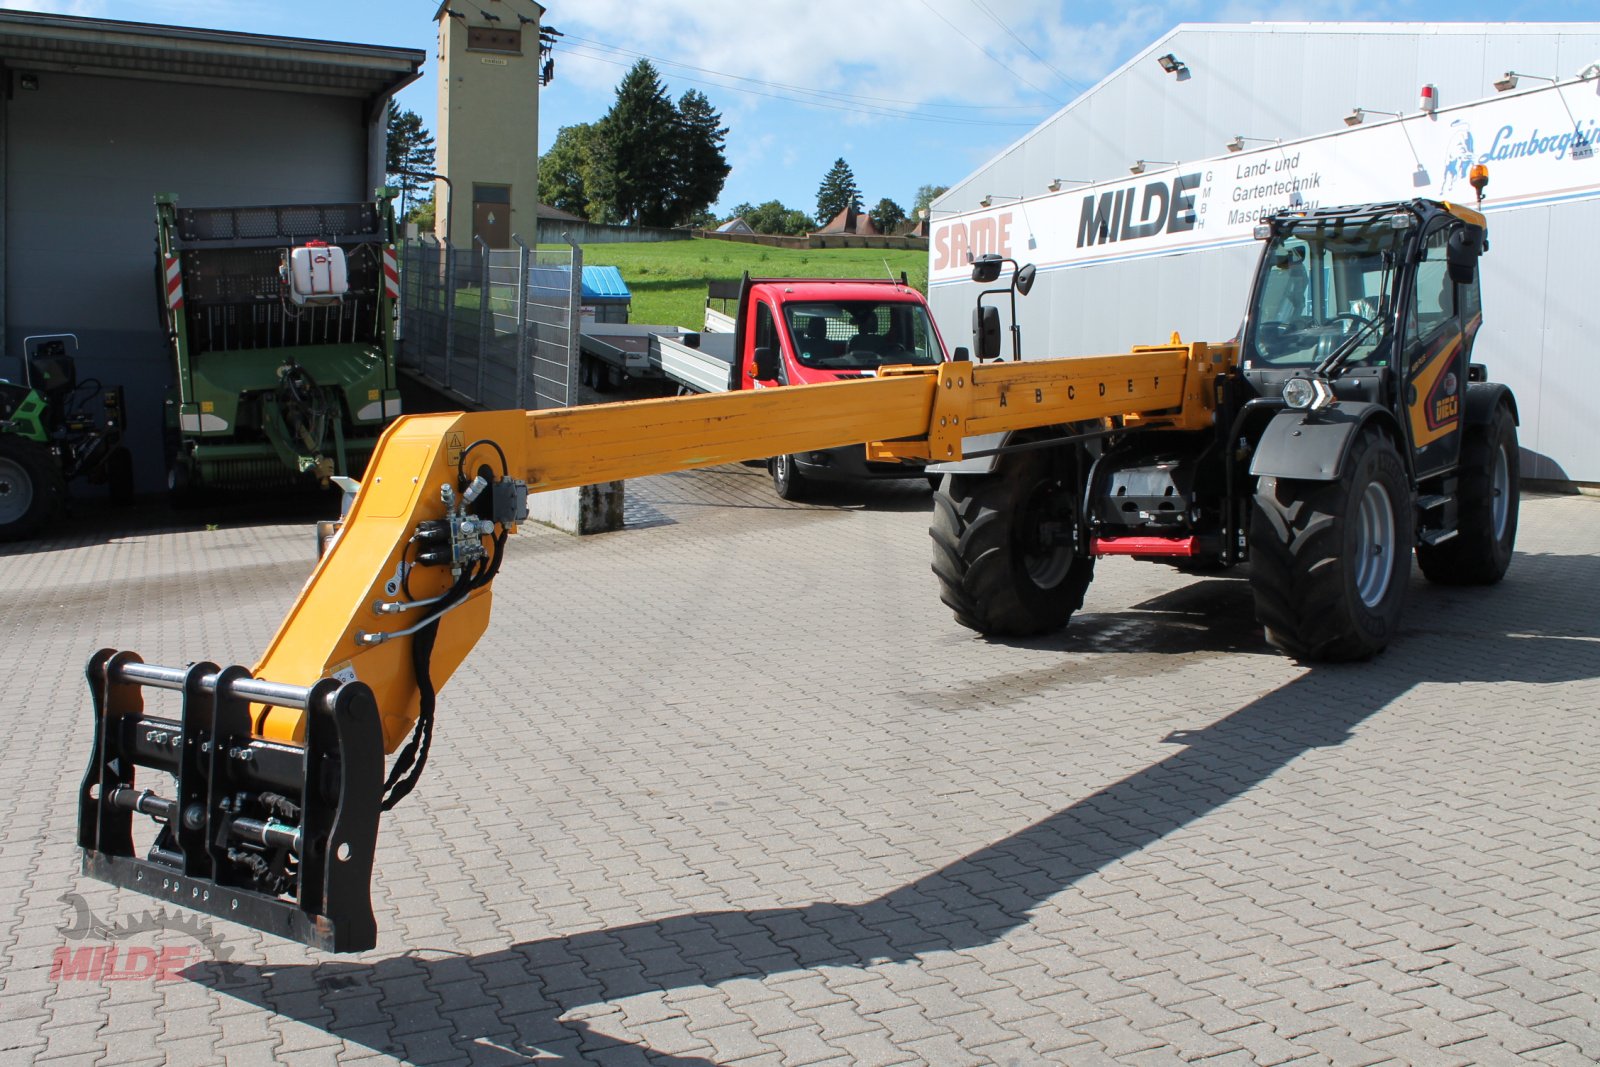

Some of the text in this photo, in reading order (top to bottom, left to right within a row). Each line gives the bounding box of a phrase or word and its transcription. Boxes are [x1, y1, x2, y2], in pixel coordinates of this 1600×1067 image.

[1236, 152, 1300, 180] Land- und
[1232, 172, 1321, 203] Gartentechnik
[1076, 172, 1202, 248] MILDE
[934, 212, 1013, 271] SAME
[1000, 376, 1159, 407] A B C D E F
